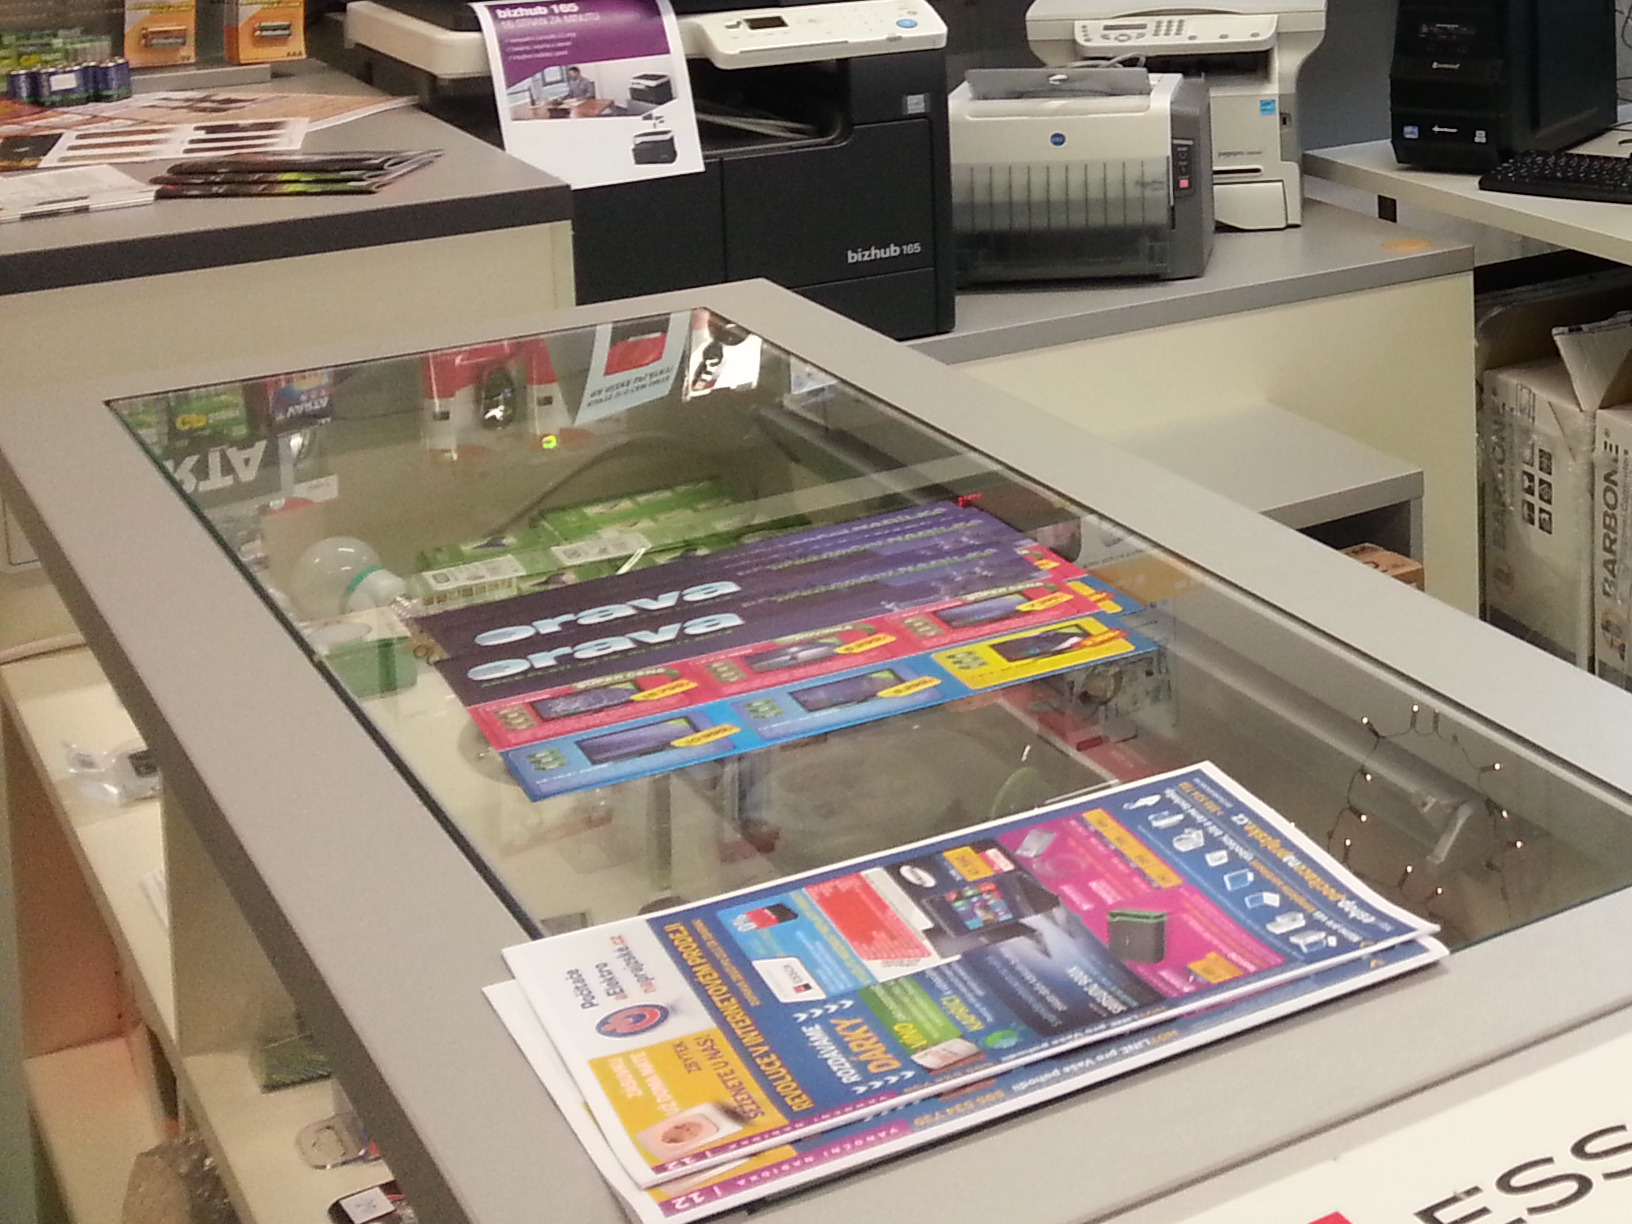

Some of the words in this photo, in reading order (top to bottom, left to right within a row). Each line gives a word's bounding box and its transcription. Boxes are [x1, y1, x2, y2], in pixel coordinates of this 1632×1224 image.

[495, 5, 549, 19] bizhub
[550, 2, 580, 14] 165
[847, 242, 901, 264] bizhub
[901, 241, 922, 256] 165
[472, 579, 743, 647] orava
[466, 611, 745, 681] orava
[662, 922, 704, 970] PRODEJI
[565, 967, 600, 1010] Počítače
[693, 968, 760, 1050] INTERNETOVÉM
[751, 1047, 771, 1062] V
[799, 1021, 861, 1086] ROZDÁVÁME
[828, 1015, 902, 1075] DÁRKY
[715, 1070, 766, 1121] SEŽENETE
[759, 1059, 816, 1113] REVOLUCE
[671, 1192, 705, 1211] 12
